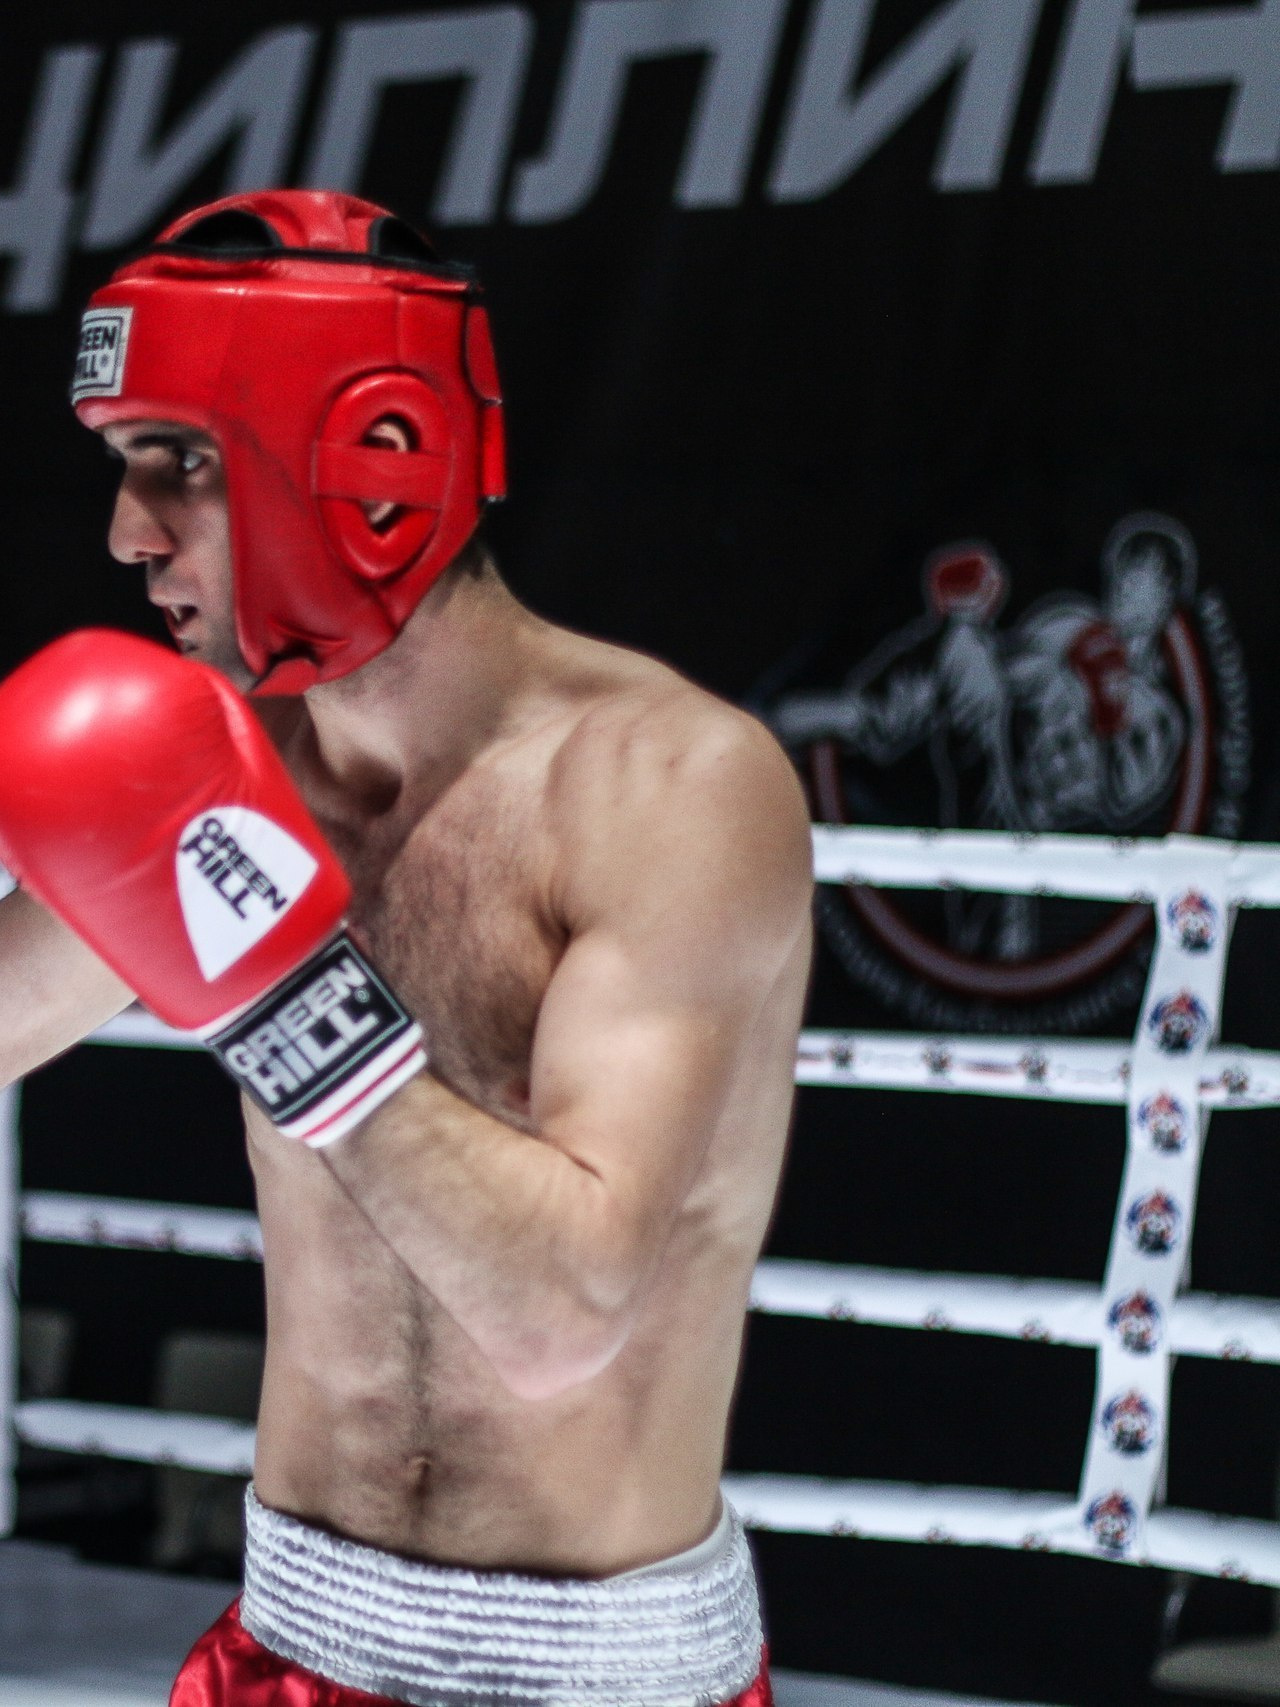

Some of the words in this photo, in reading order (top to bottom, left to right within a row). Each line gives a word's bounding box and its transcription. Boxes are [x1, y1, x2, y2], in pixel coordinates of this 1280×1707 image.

[181, 833, 248, 920] HILL
[202, 817, 288, 912] GREEN
[225, 956, 368, 1077] GREEN
[246, 1005, 380, 1105] HILL
